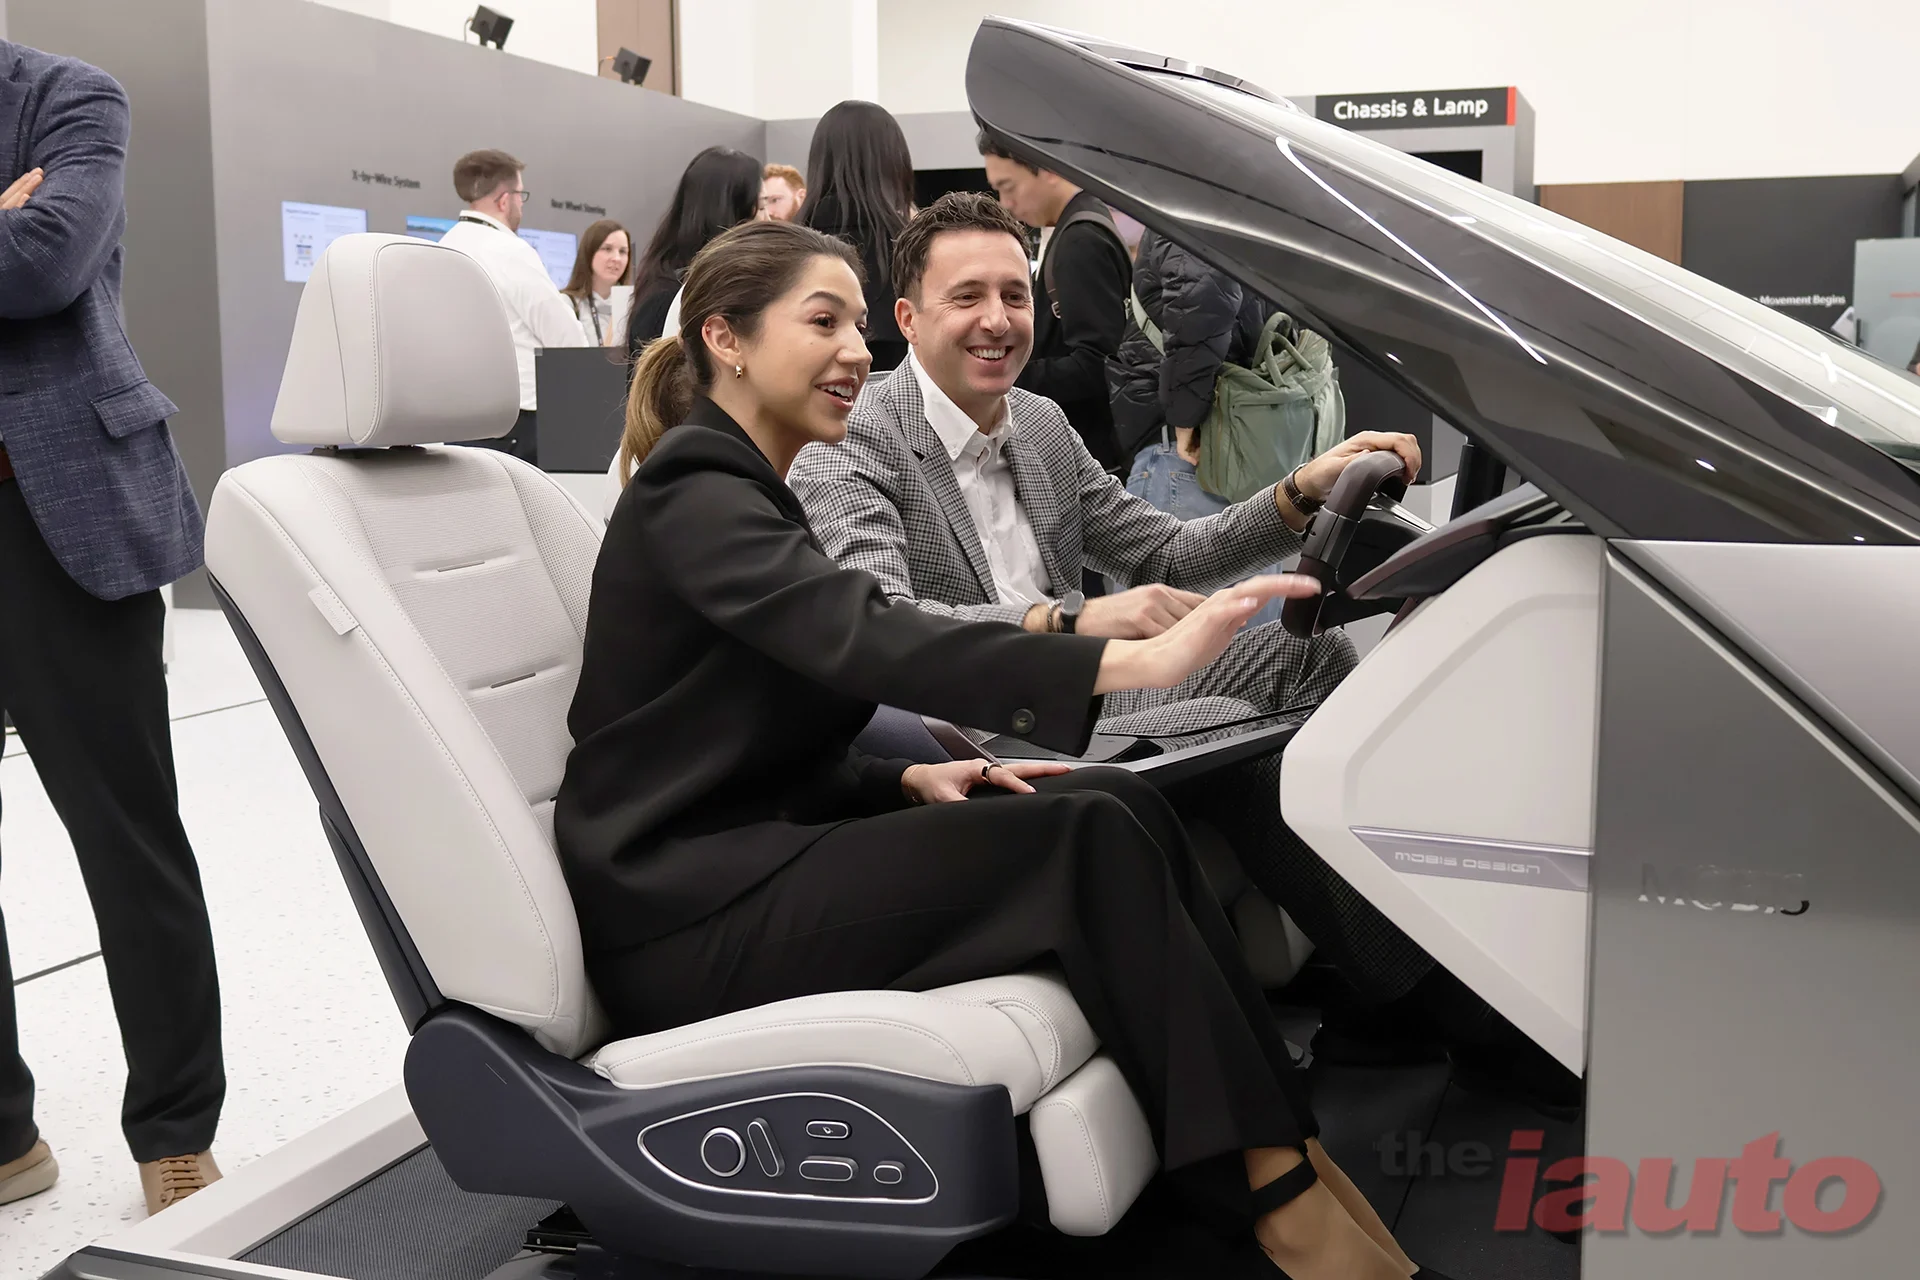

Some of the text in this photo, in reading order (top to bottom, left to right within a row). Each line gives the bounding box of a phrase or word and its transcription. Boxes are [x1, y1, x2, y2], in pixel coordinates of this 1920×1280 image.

[1333, 97, 1489, 120] Chassis & Lamp
[394, 175, 421, 190] System
[1760, 294, 1811, 306] Movement
[1812, 294, 1846, 308] Begins
[1394, 851, 1458, 867] MOBIS
